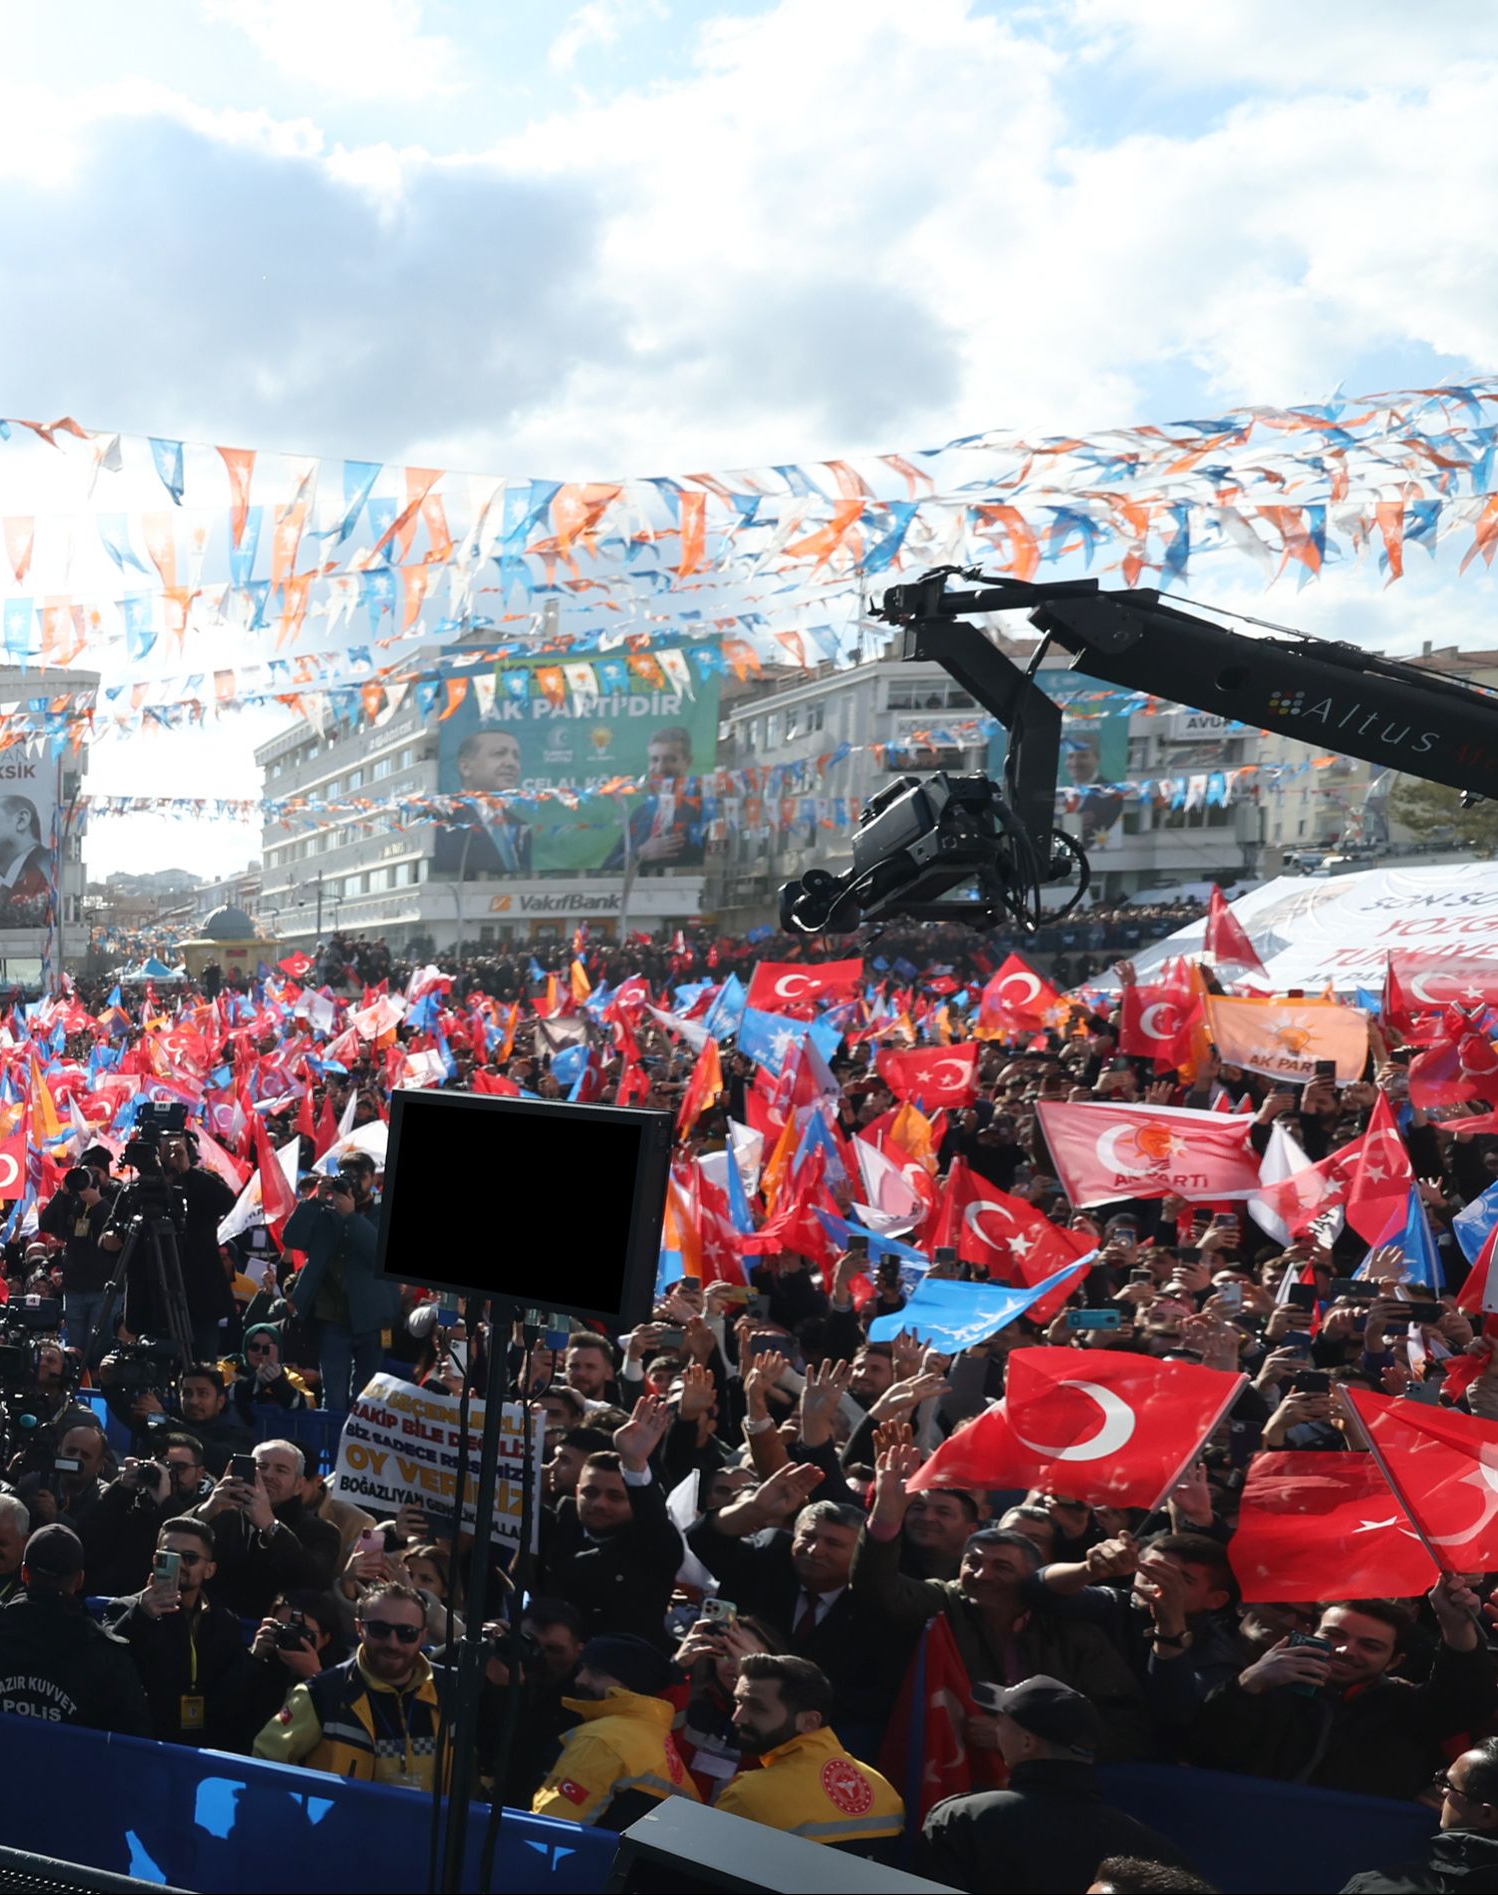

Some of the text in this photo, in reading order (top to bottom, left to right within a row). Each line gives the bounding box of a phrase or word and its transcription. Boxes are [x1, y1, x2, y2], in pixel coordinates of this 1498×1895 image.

[480, 702, 523, 722] AK
[1301, 698, 1441, 752] Altus
[1249, 1055, 1275, 1068] AK
[351, 1401, 398, 1429] RAKİP
[402, 1416, 445, 1445] BİLE
[345, 1422, 370, 1439] BİZ
[373, 1432, 437, 1465] SADECE
[346, 1443, 389, 1476] OY
[340, 1475, 424, 1507] BOĞAZLIYAN
[3, 1699, 62, 1722] POLİS
[28, 1676, 77, 1715] KUVVET
